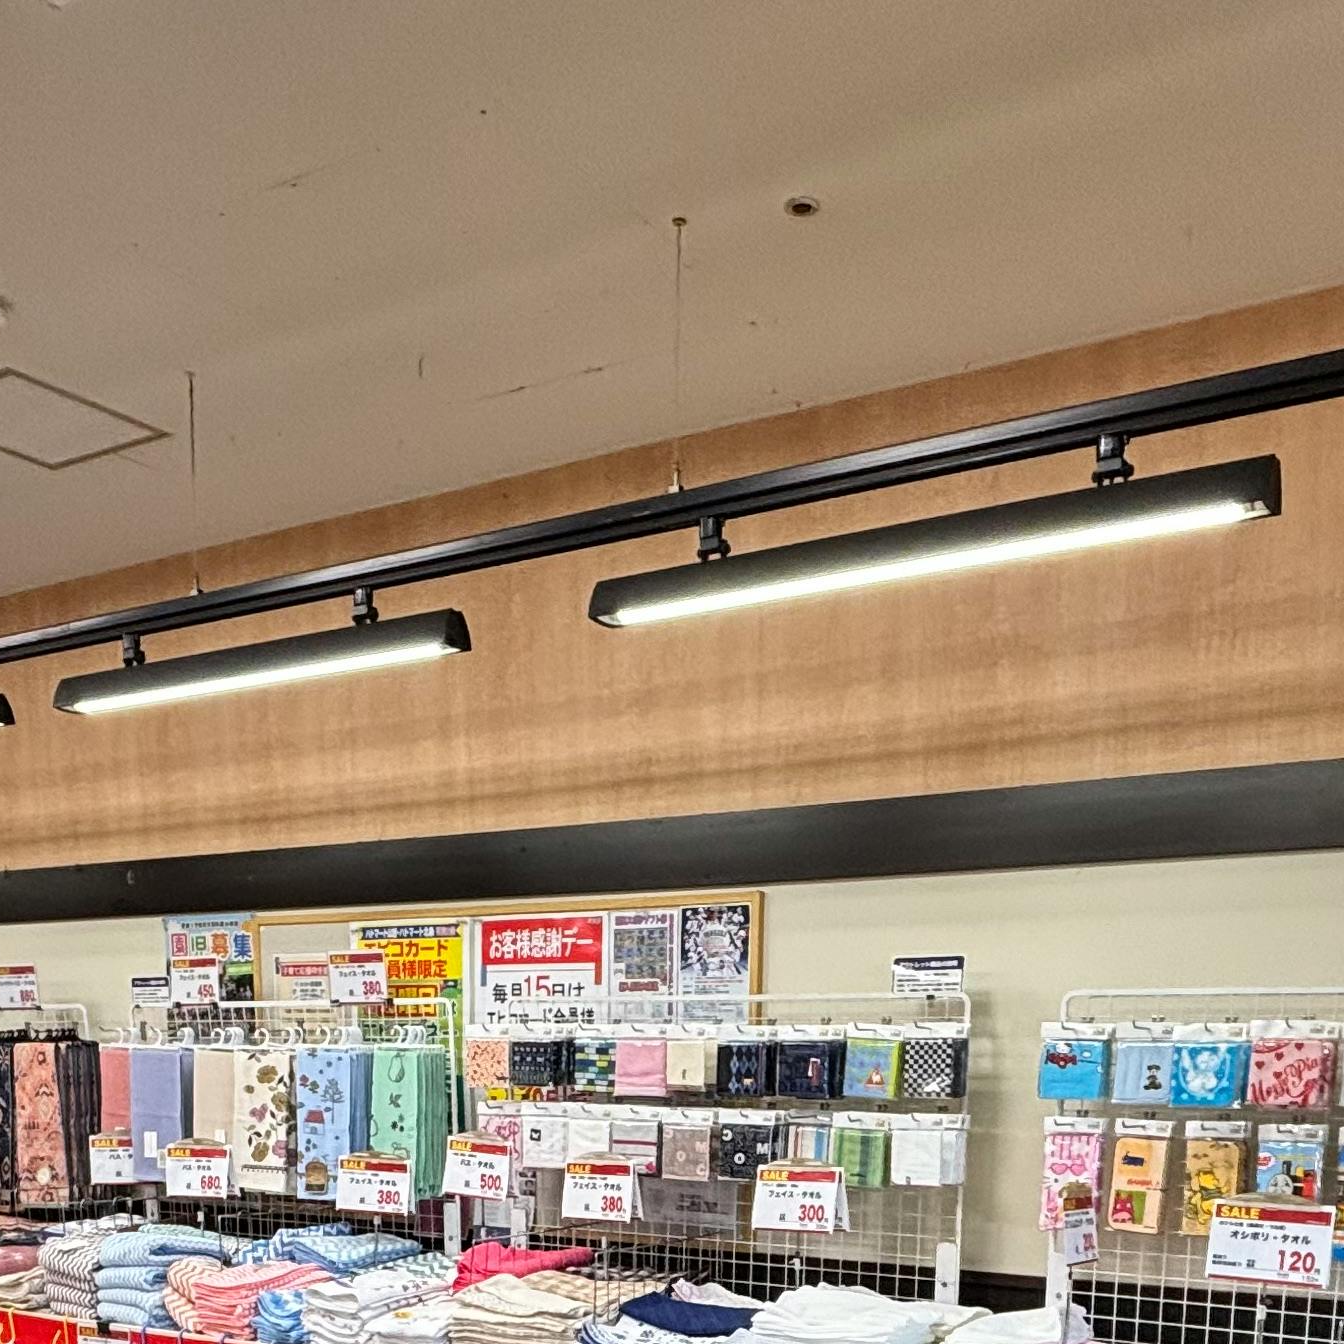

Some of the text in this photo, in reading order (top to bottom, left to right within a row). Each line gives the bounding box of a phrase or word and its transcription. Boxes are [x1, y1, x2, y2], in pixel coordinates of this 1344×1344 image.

[489, 926, 594, 959] お客様感謝デー
[362, 981, 381, 995] 380
[451, 1140, 472, 1151] SALE
[170, 1148, 191, 1157] SALE
[342, 1160, 366, 1169] SALE
[568, 1165, 592, 1174] SALE
[761, 1172, 788, 1181] SALE
[200, 1175, 220, 1190] 680
[349, 1177, 397, 1187] フェイス・タオル
[572, 1181, 622, 1191] フェイス・タオル
[768, 1190, 822, 1200] フェイス・タオル
[1220, 1205, 1261, 1219] SALE
[1230, 1230, 1312, 1245] オシボリ・タオル
